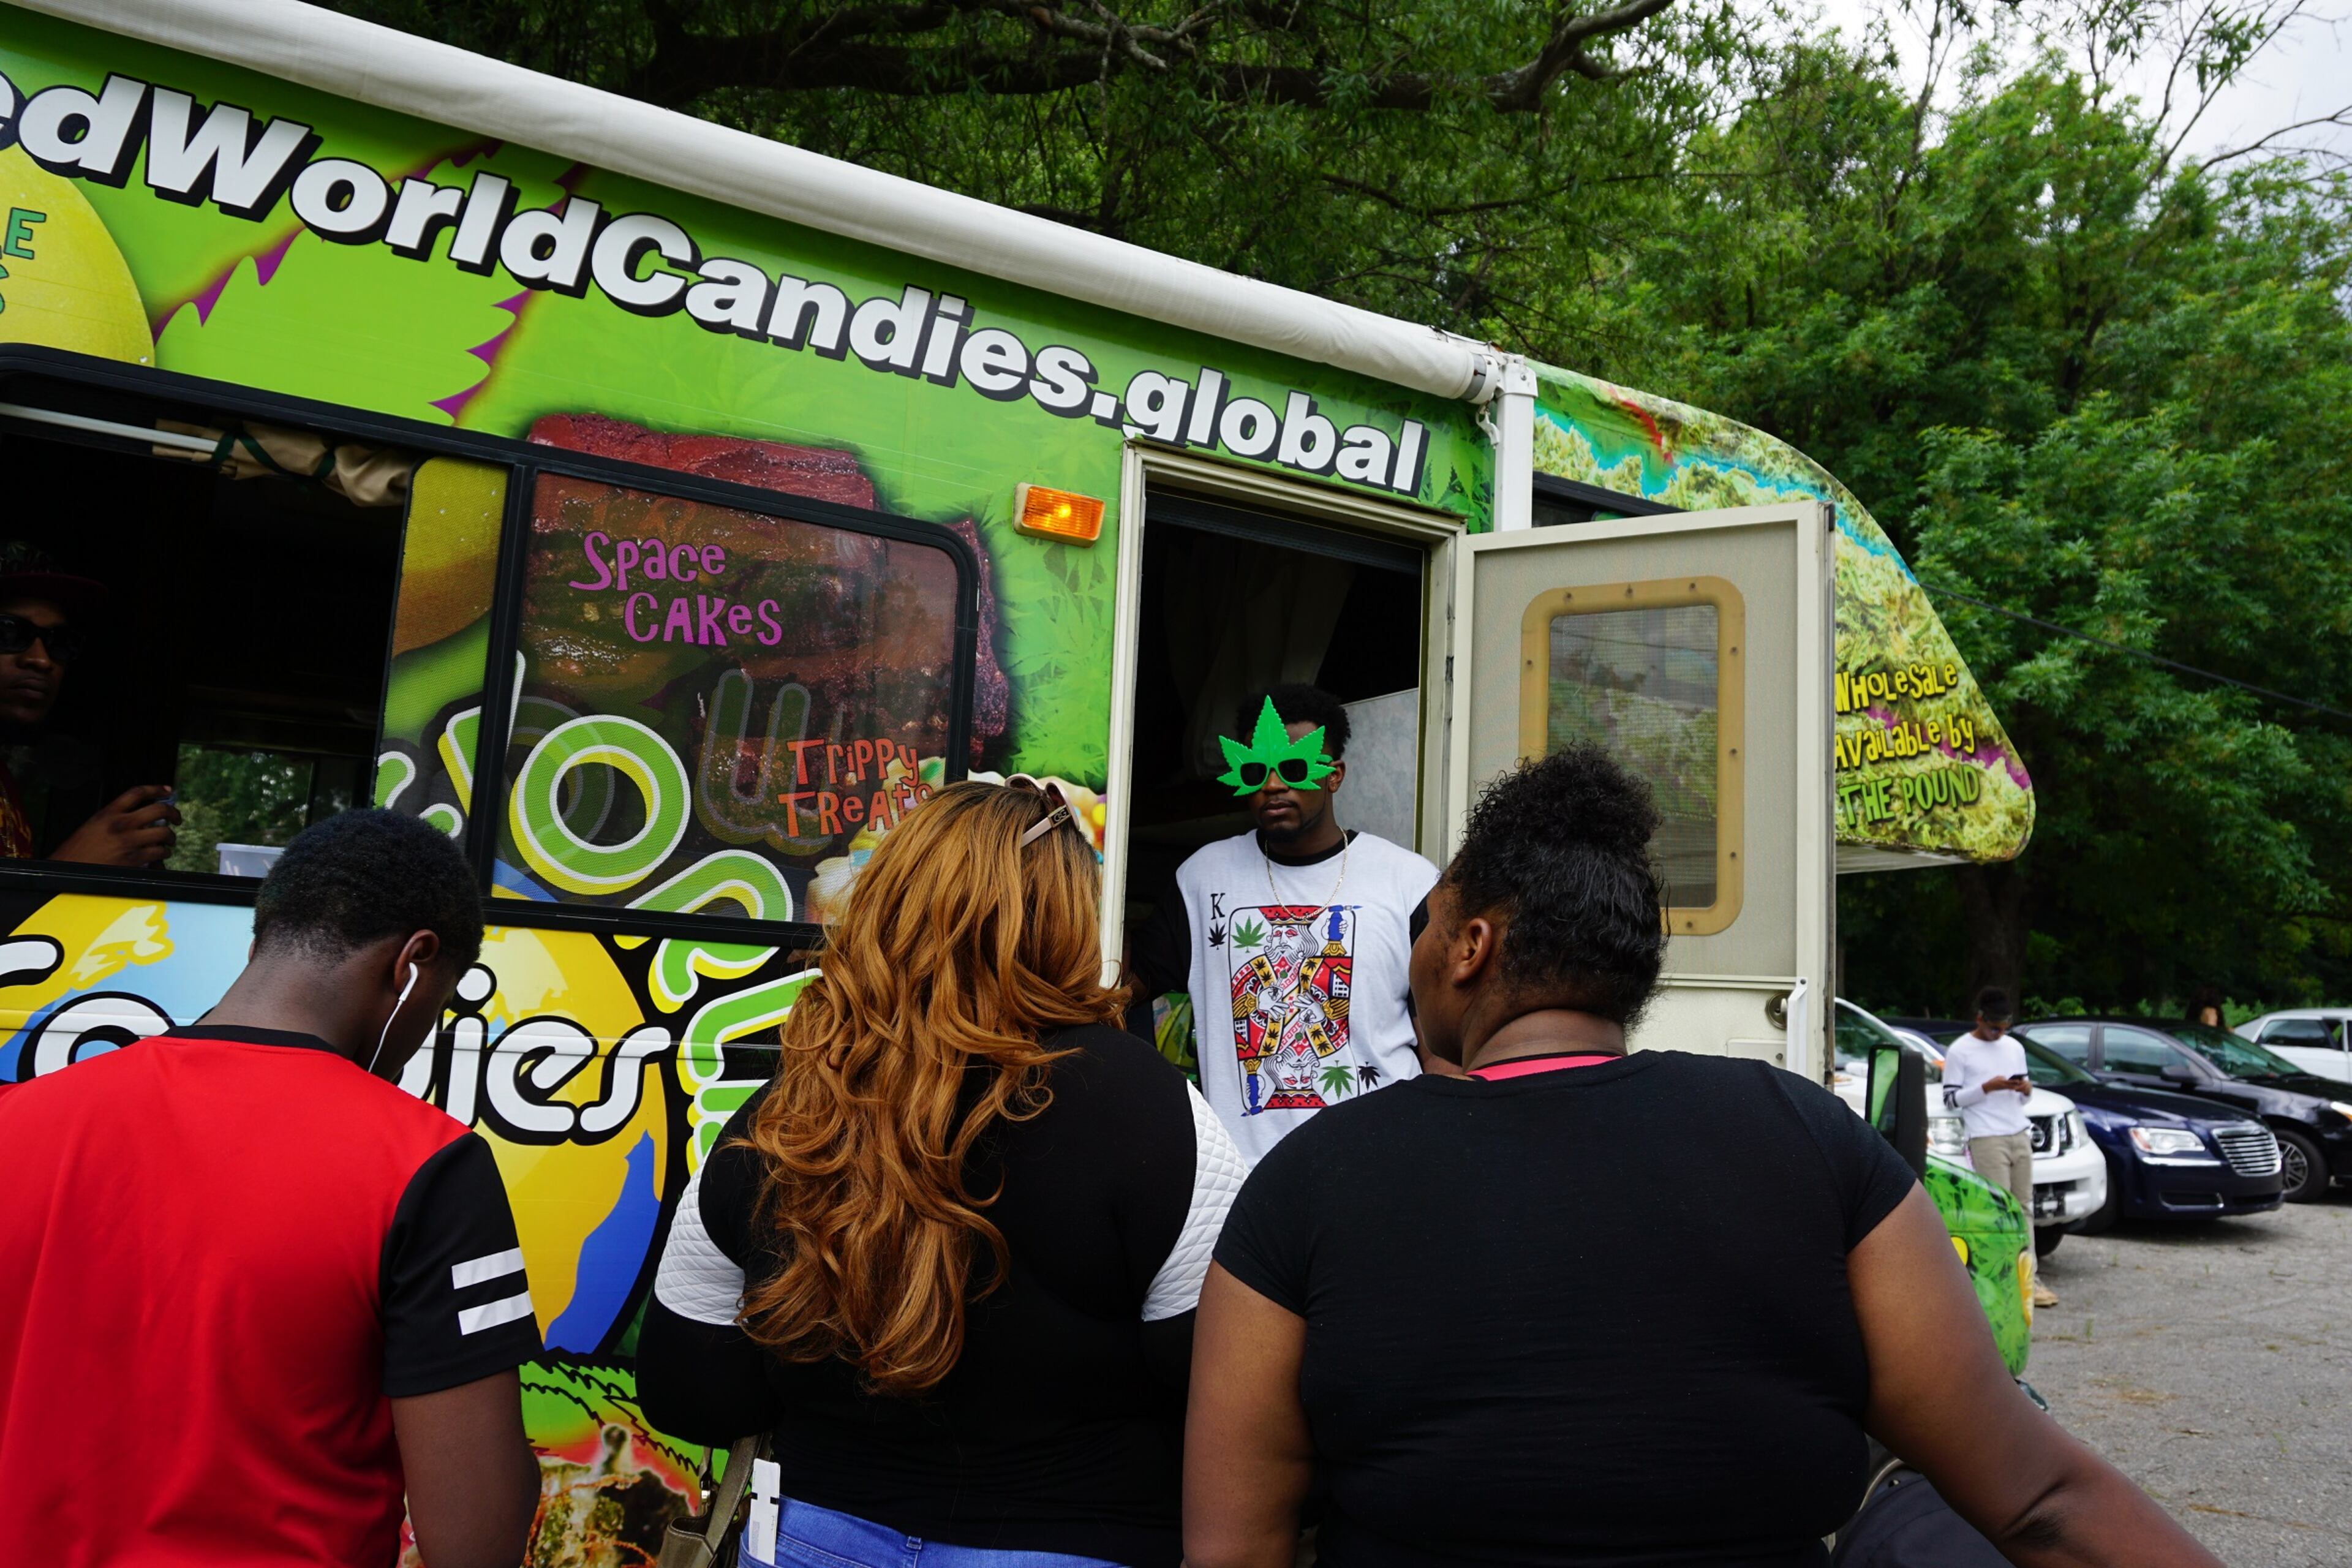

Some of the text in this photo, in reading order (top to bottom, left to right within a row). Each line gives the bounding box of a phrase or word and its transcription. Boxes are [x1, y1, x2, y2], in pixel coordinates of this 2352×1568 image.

[0, 70, 1430, 495] dWorldCandies.global
[568, 530, 726, 591] Space
[1947, 714, 1976, 754] by
[1839, 764, 1980, 827] THE POUND
[1210, 892, 1226, 920] K
